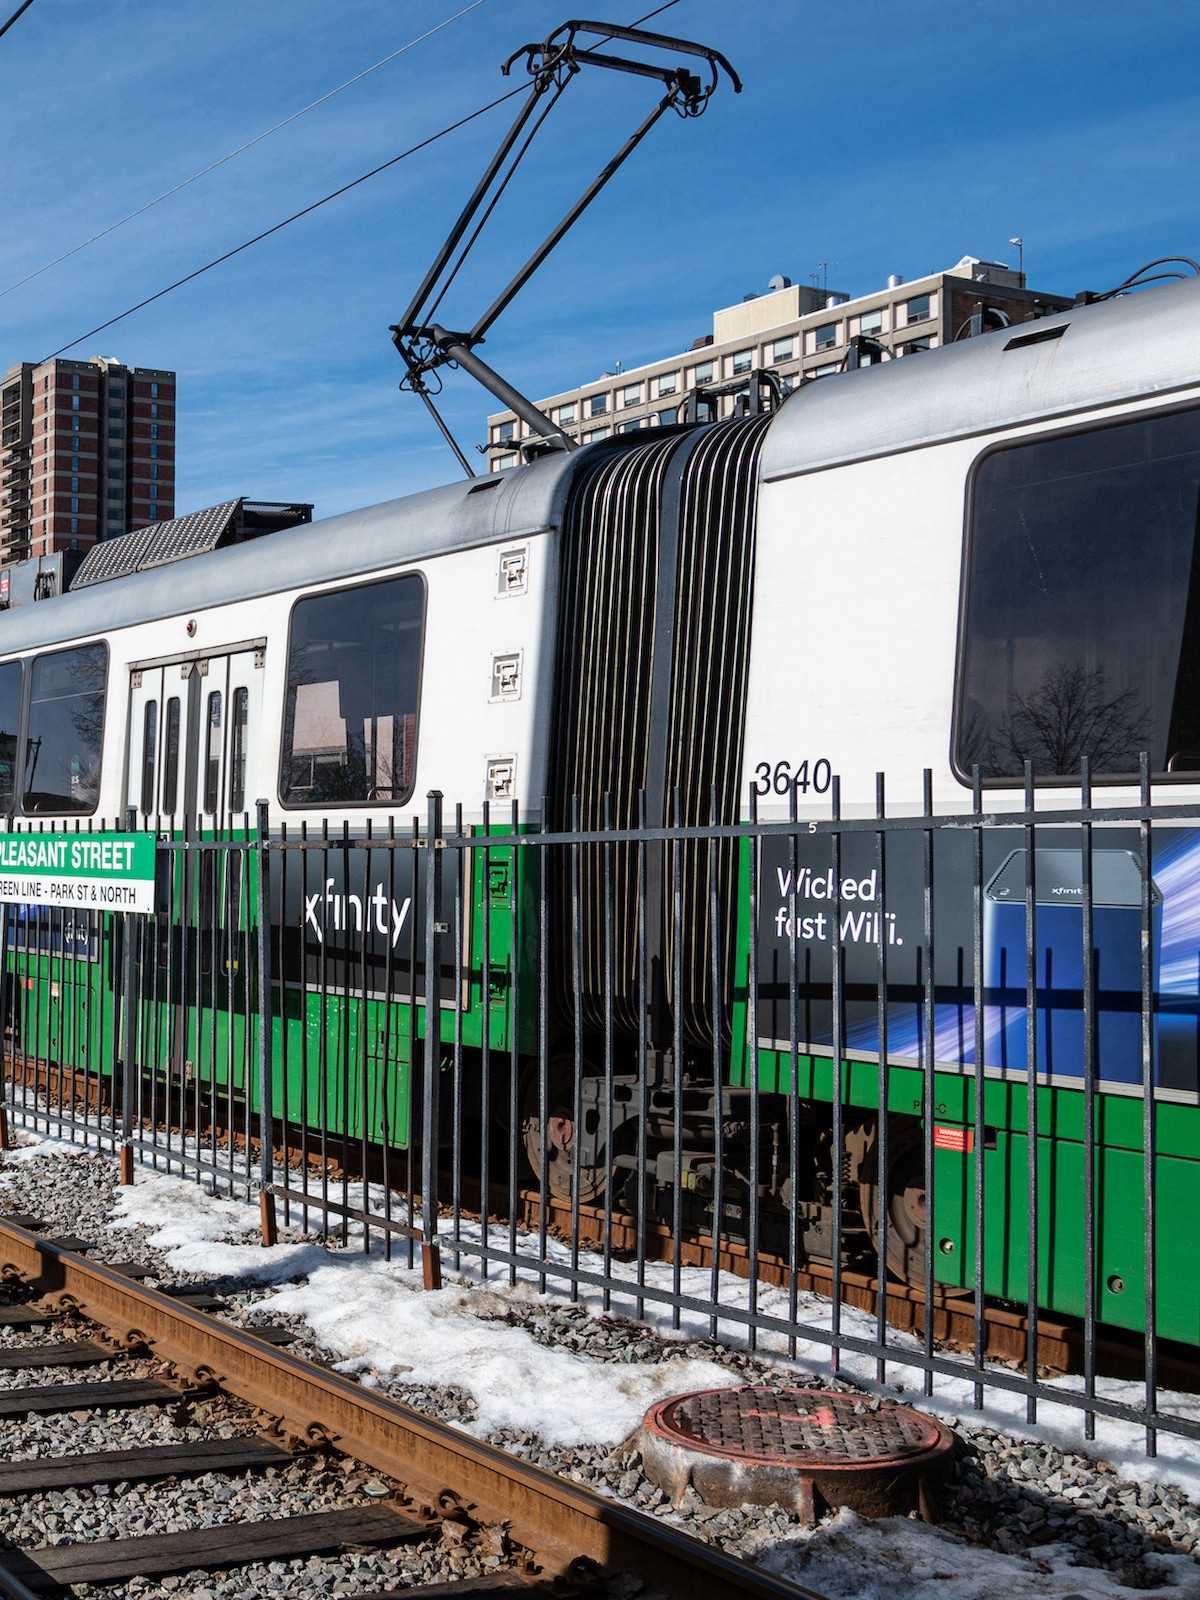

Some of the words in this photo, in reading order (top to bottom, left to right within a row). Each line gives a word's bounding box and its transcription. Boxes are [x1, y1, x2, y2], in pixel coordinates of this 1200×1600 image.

[755, 758, 832, 796] 3640
[71, 841, 136, 871] STREET
[21, 882, 42, 897] LINE
[50, 883, 74, 900] PARK
[77, 884, 88, 900] ST
[91, 886, 97, 901] &
[100, 886, 136, 904] NORTH
[1051, 887, 1084, 896] xfinit
